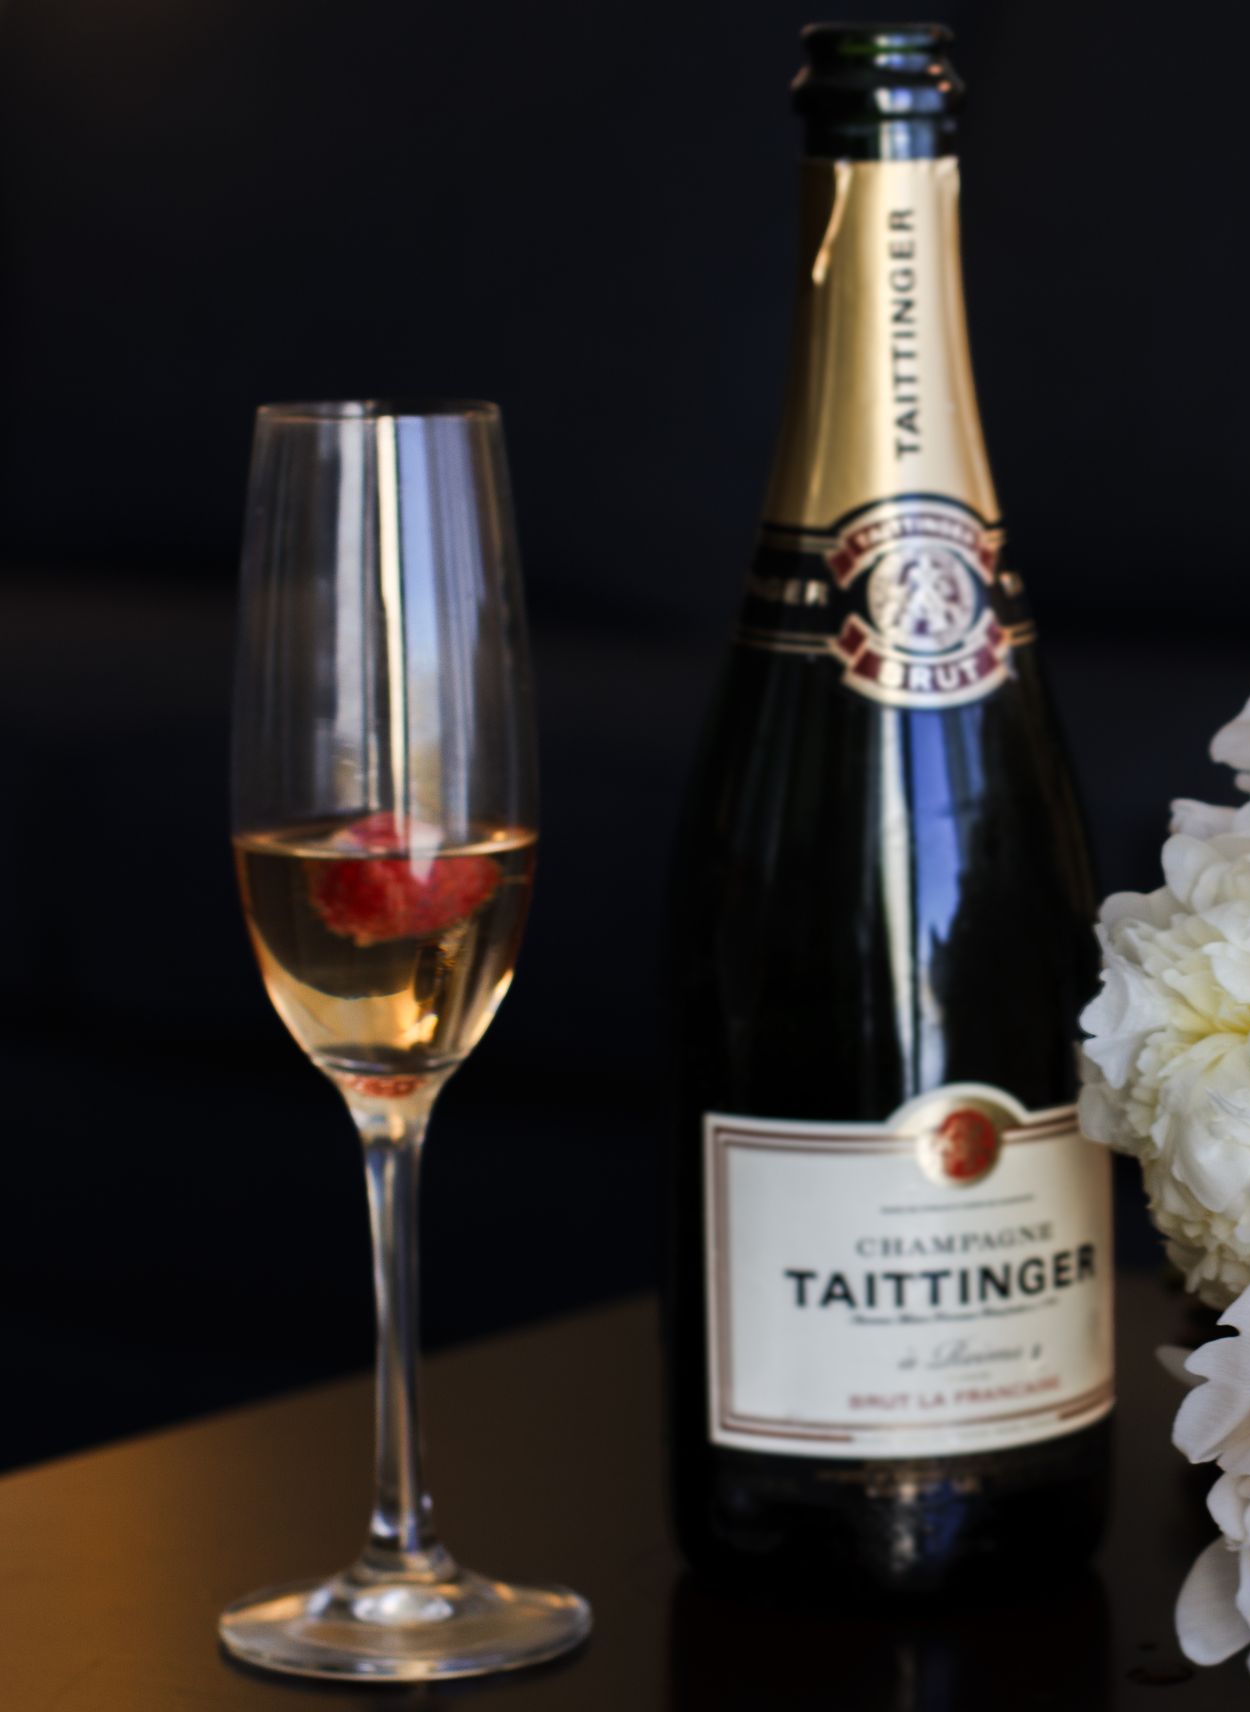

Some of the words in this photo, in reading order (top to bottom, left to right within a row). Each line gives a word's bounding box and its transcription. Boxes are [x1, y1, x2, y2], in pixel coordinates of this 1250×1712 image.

[888, 207, 921, 461] TAITTINGER
[878, 660, 978, 692] BRUT
[856, 1222, 1055, 1258] CHAMPAGNE
[784, 1242, 1096, 1309] TAITTINGER
[848, 1392, 909, 1411] BRUT
[918, 1391, 946, 1411] LA
